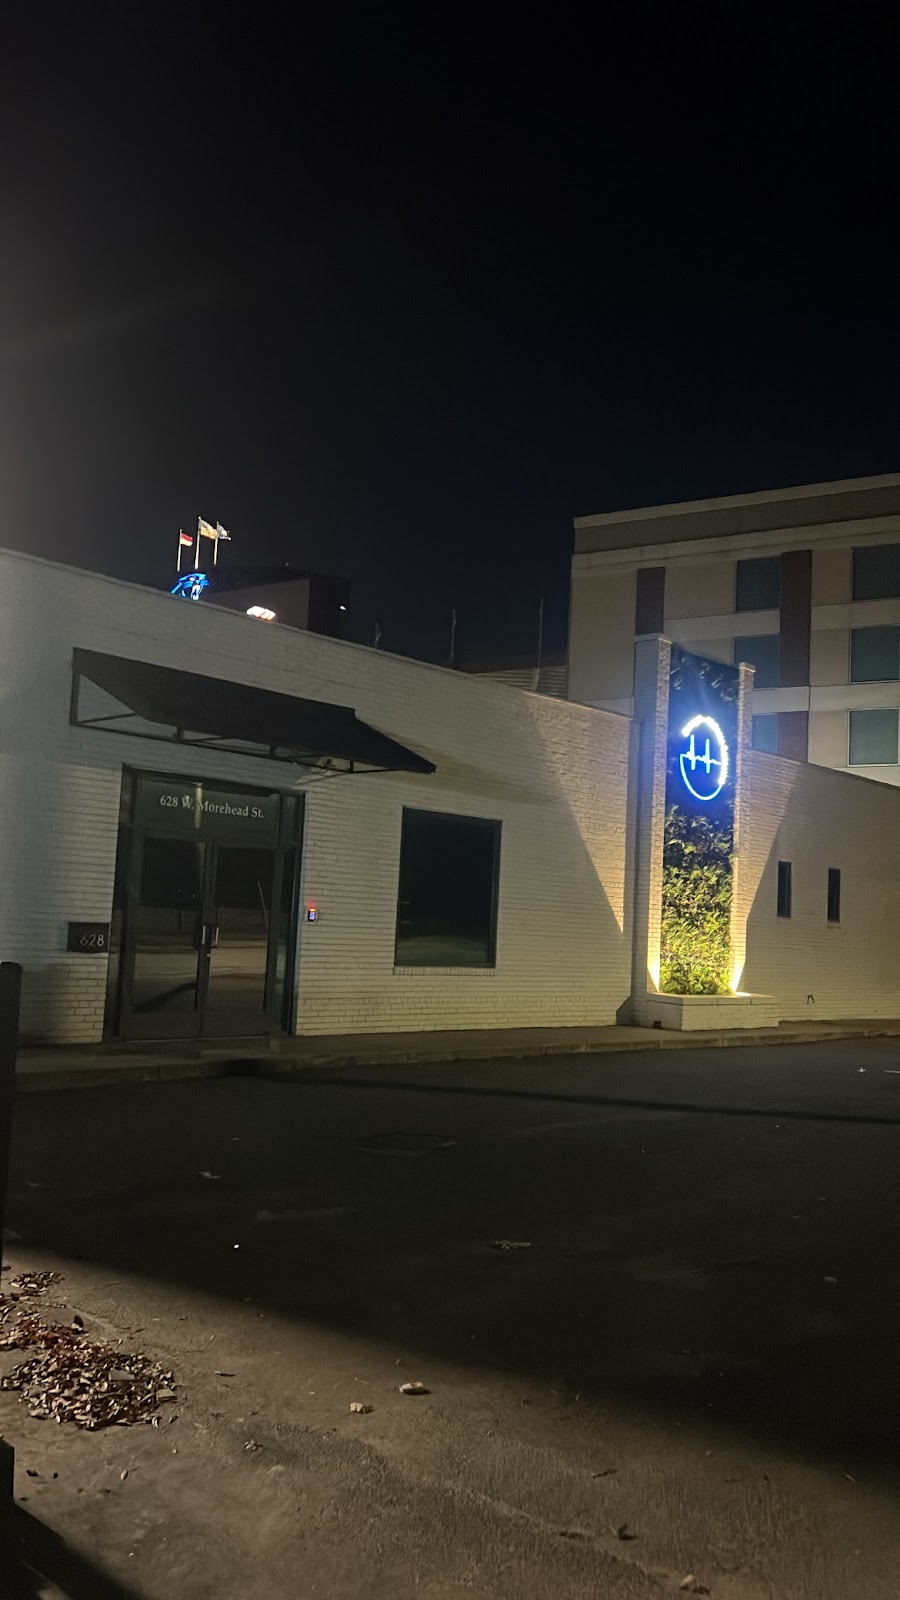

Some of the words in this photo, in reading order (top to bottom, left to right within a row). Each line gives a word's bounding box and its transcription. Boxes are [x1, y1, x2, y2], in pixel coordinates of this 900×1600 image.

[159, 795, 178, 807] 628
[182, 795, 195, 809] W.
[196, 799, 249, 817] Morehead
[251, 807, 264, 818] St.
[79, 933, 105, 947] 628
